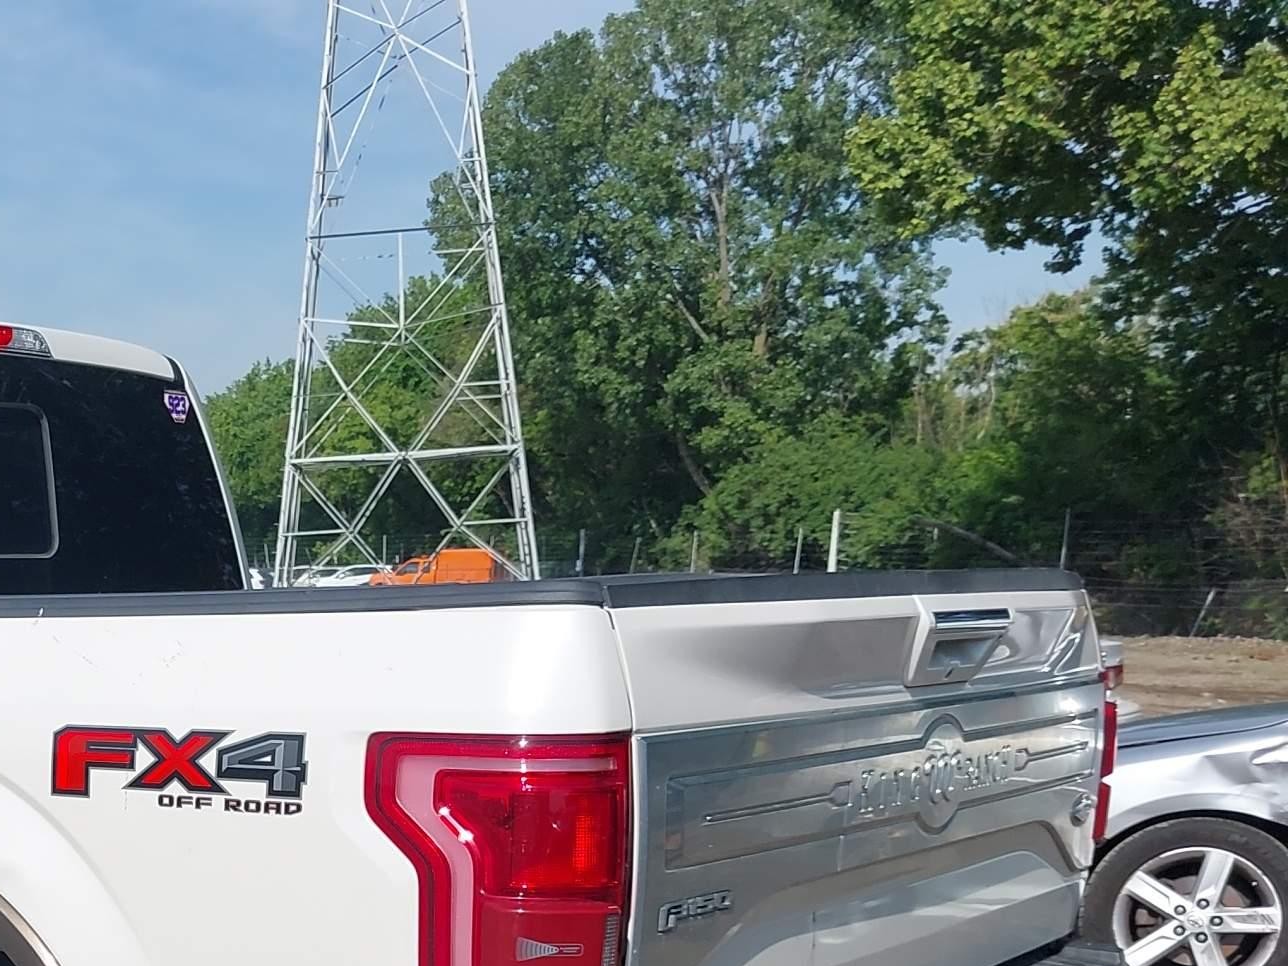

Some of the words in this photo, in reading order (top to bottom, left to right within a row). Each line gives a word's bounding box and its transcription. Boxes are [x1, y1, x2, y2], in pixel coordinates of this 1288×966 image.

[51, 724, 308, 799] FX4
[158, 794, 213, 810] OFF
[223, 797, 302, 815] ROAD
